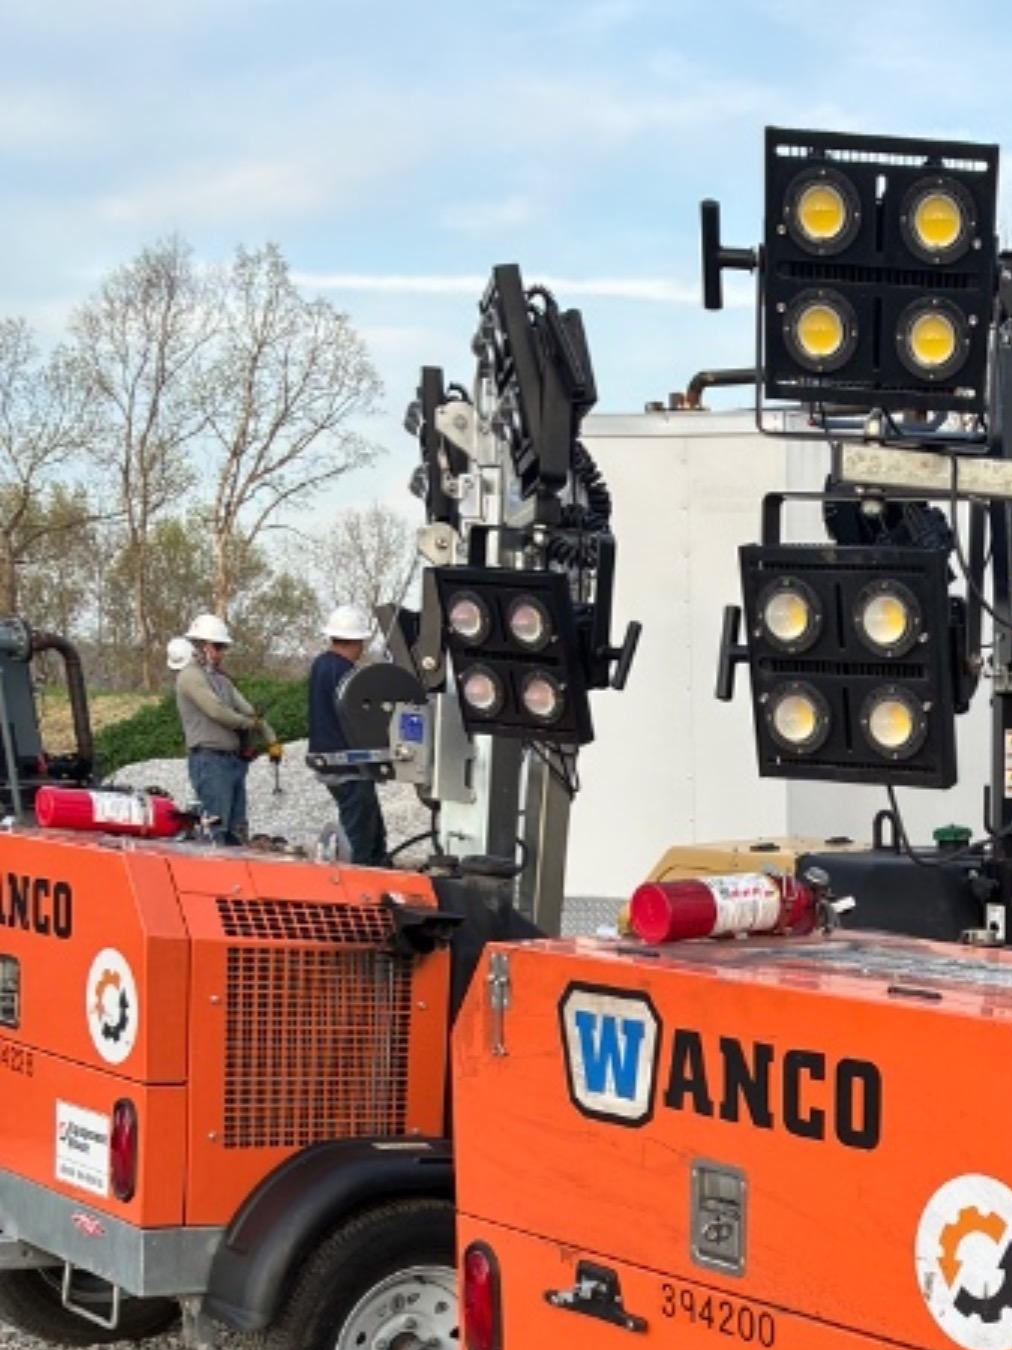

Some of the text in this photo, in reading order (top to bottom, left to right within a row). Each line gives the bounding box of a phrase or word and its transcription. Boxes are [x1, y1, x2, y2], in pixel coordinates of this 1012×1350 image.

[0, 872, 72, 939] NCO
[574, 1009, 883, 1151] WANCO
[661, 1283, 775, 1347] 394200
